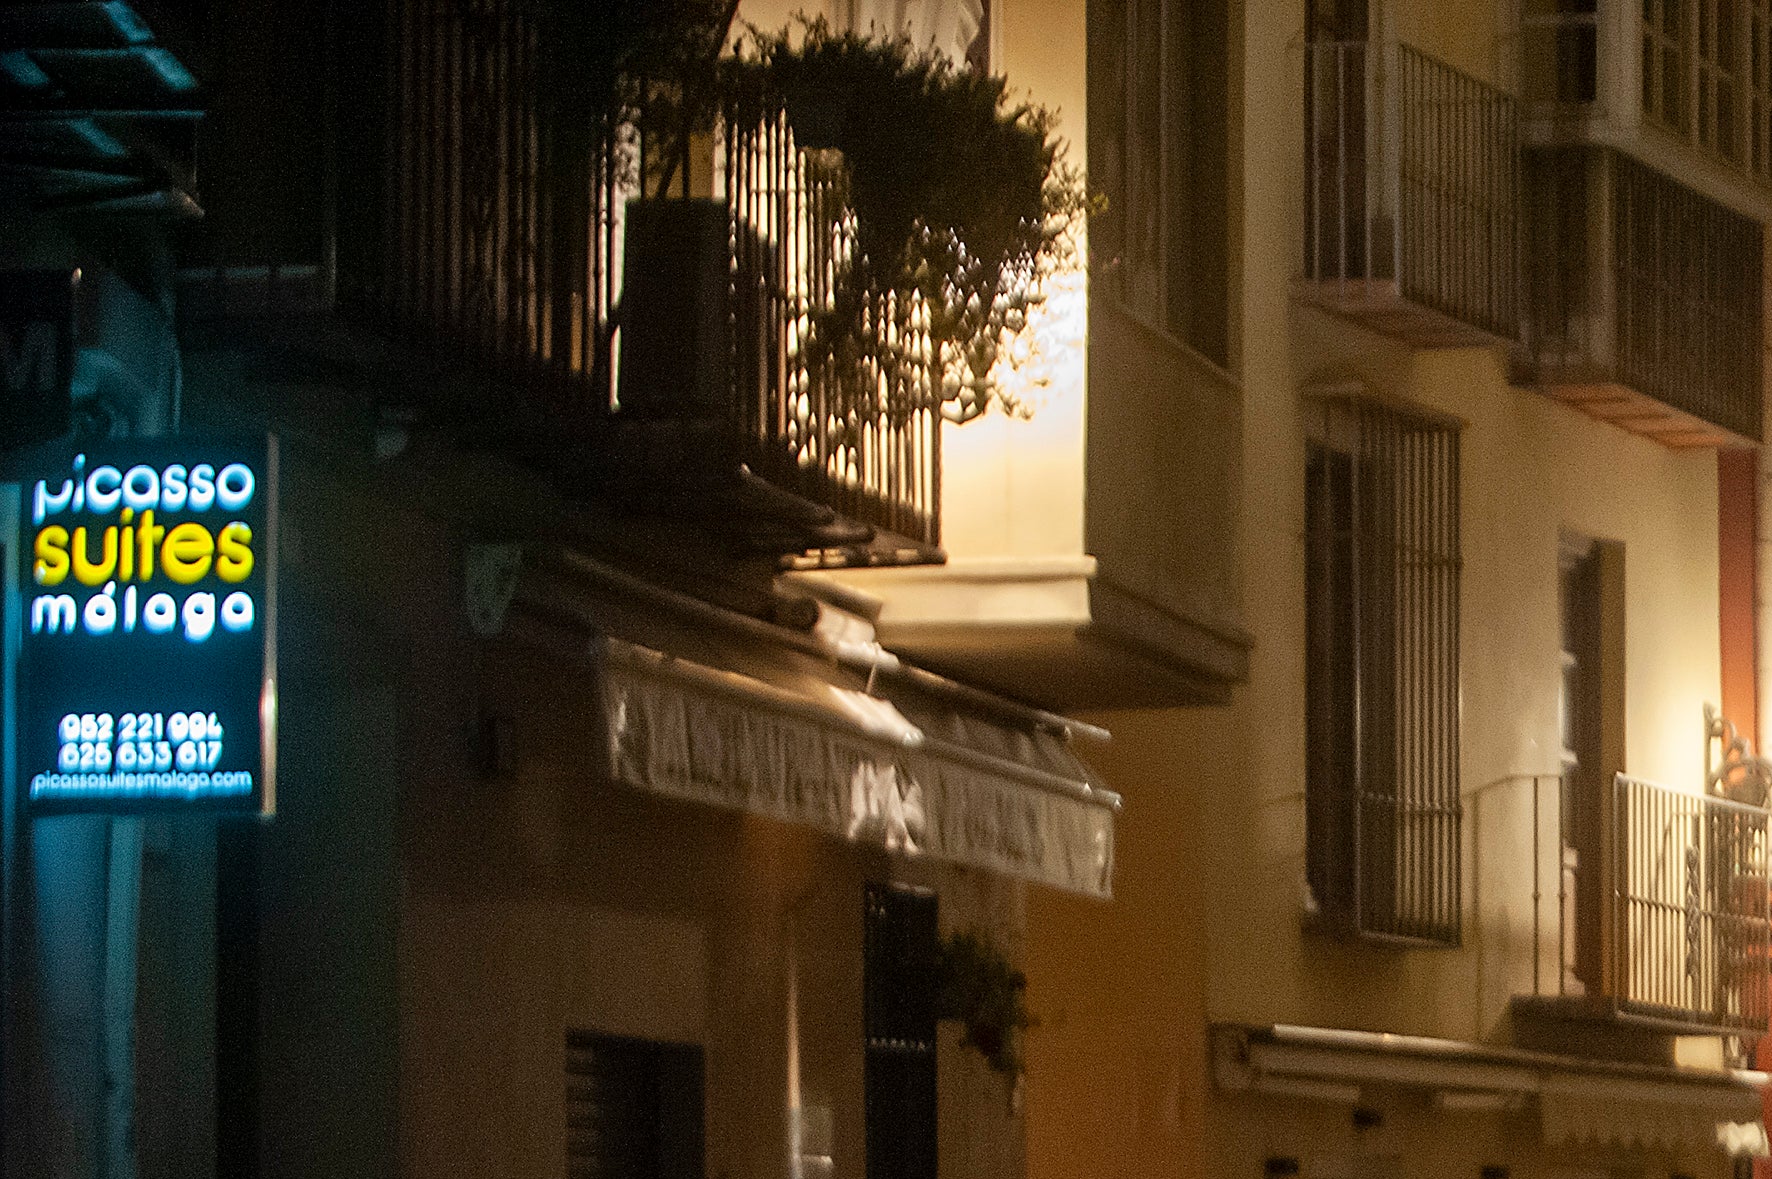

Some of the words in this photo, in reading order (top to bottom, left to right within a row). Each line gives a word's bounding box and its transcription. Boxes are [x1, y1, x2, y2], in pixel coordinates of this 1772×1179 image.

[32, 453, 255, 526] picasso
[34, 507, 254, 586] suites
[31, 580, 254, 643] málaga
[117, 712, 163, 742] 221
[58, 742, 112, 773] 625
[115, 741, 172, 773] 633
[175, 740, 223, 773] 617
[31, 769, 253, 799] picassosuitesmalaga.com
